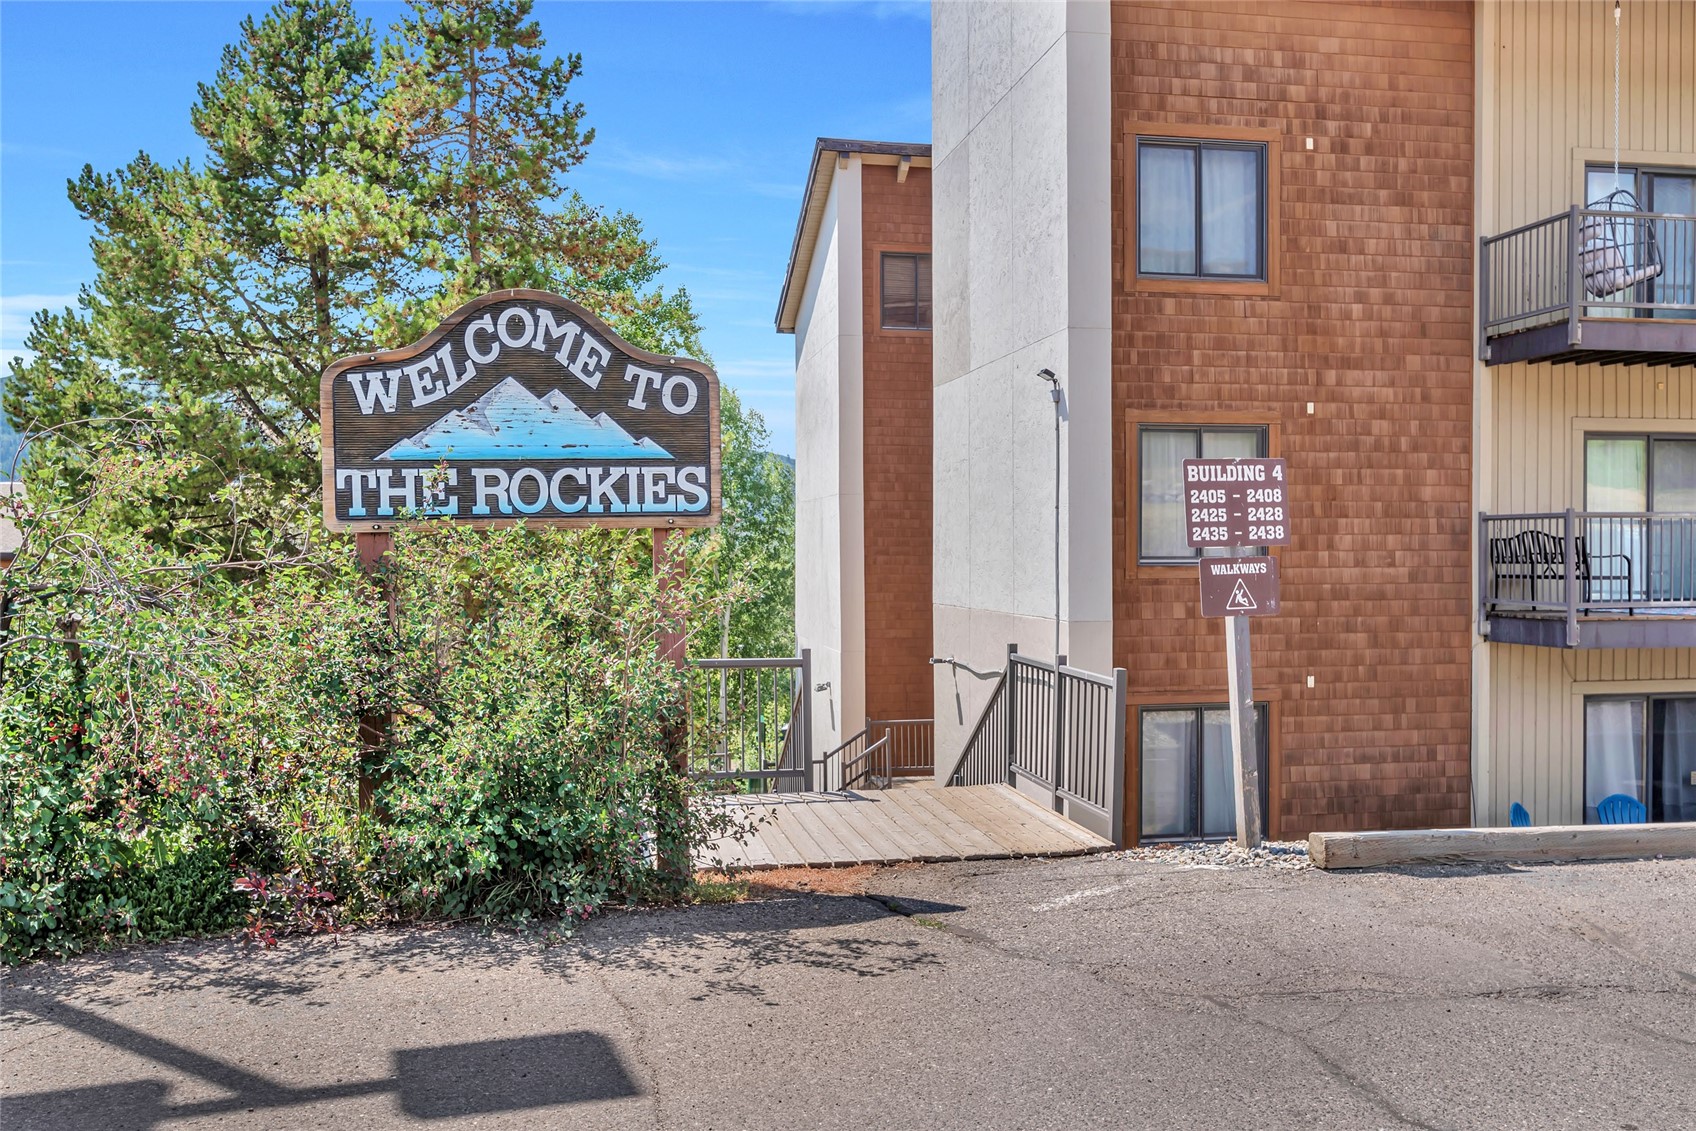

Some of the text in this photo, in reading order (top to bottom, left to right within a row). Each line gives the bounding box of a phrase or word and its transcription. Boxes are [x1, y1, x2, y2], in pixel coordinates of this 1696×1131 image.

[346, 307, 698, 415] WELCOME TO
[1187, 465, 1283, 481] BUILDING 4
[336, 466, 708, 516] THE ROCKIES
[1190, 489, 1226, 503] 2405
[1246, 488, 1282, 502] 2408
[1191, 508, 1227, 522] 2425
[1247, 507, 1283, 521] 2428
[1192, 526, 1228, 541] 2435
[1248, 525, 1284, 539] 2438
[1210, 563, 1267, 575] WALKWAYS
